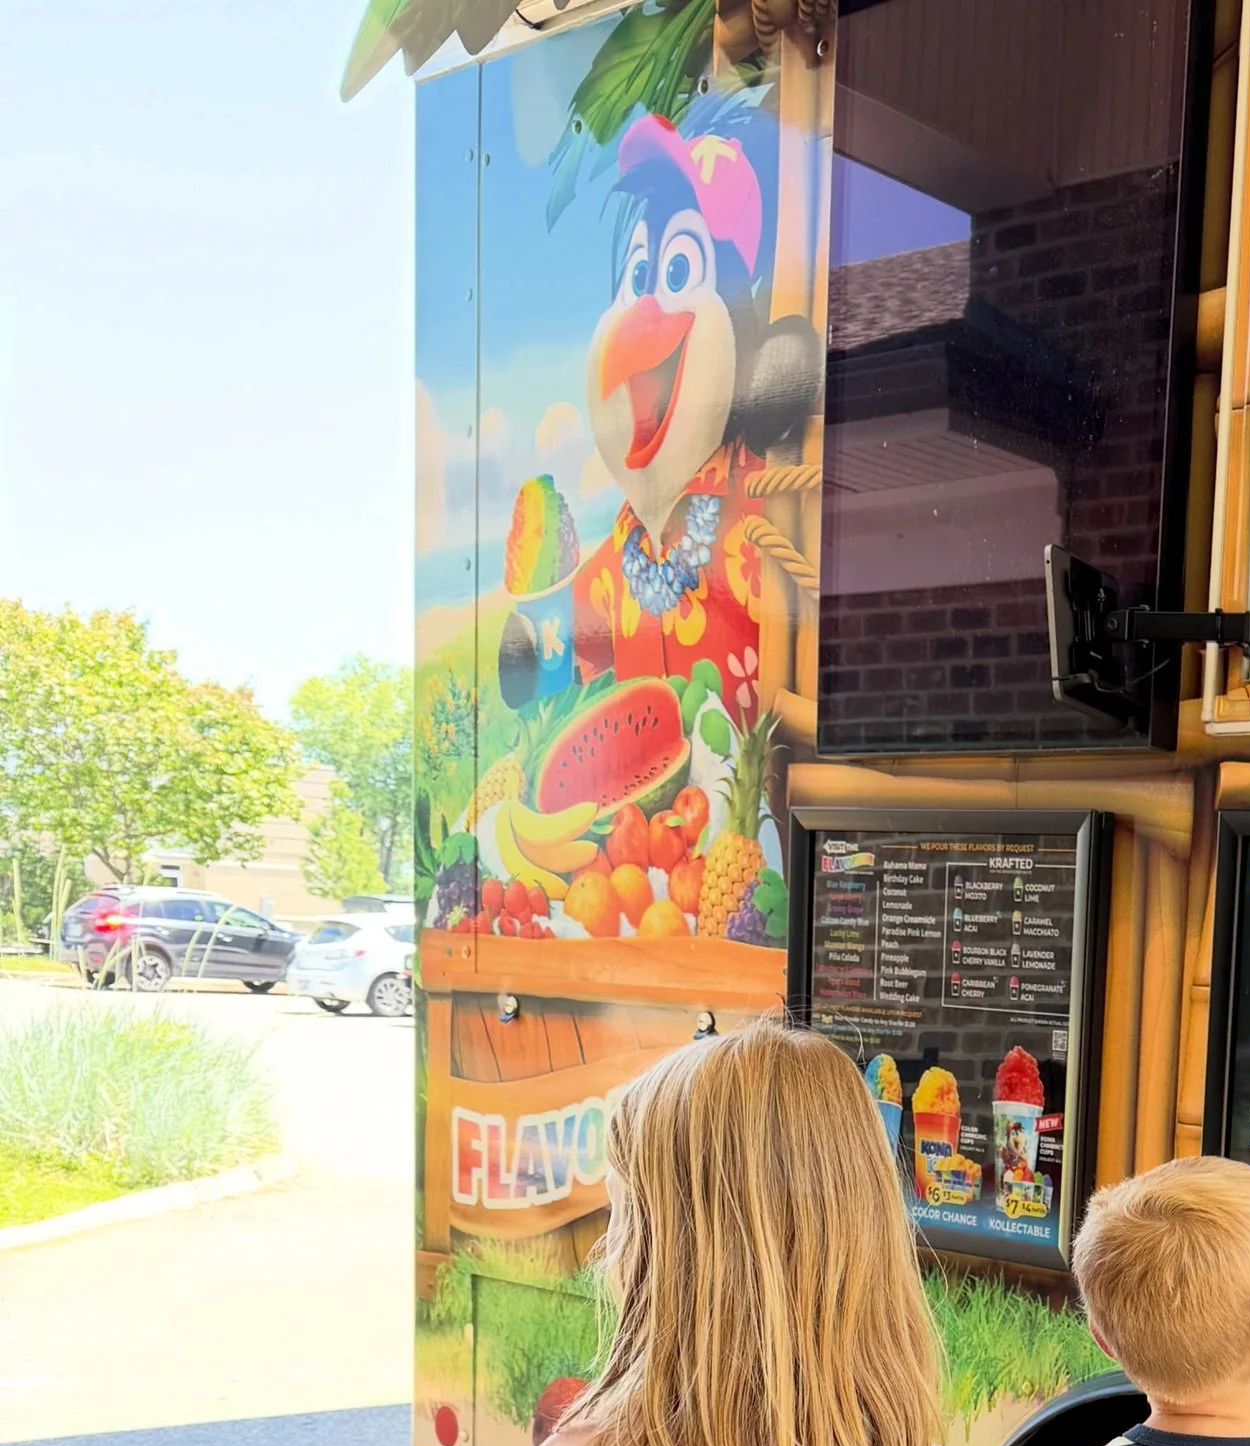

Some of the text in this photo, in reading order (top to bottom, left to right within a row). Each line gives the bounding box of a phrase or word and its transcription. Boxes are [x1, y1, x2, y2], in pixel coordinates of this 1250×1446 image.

[931, 843, 949, 851] POUR
[949, 843, 968, 851] THESE
[969, 844, 996, 852] FLAVORS
[1006, 844, 1035, 853] REQUEST
[988, 858, 1034, 870] KRAFTED
[882, 874, 924, 886] Birthday Cake
[964, 881, 1004, 891] BLACKBERRY
[1024, 884, 1056, 893] COCONUT
[882, 887, 907, 897] Coconut
[1024, 895, 1040, 903] LIME
[882, 900, 913, 911] Lemonade
[881, 913, 936, 925] Orange Creamsicle
[963, 913, 998, 923] BLUEBERRY
[1023, 916, 1053, 926] CARAMEL
[1023, 927, 1060, 938] MACCHIATO
[880, 939, 900, 950] Peach
[962, 946, 1008, 957] BOURBON BLACK
[1022, 950, 1055, 960] LAVENDER
[880, 952, 910, 964] Pineapple
[962, 956, 1006, 967] CHERRY VANILLA
[1021, 960, 1056, 971] LEMONADE
[961, 978, 996, 990] CARIBBEAN
[1020, 983, 1064, 994] POMEGRANATE
[961, 989, 986, 999] CHERRY
[1038, 1117, 1059, 1130] NEW
[452, 1090, 618, 1209] FLAVO
[919, 1139, 953, 1158] KONA
[927, 1186, 940, 1203] $6
[1005, 1197, 1019, 1215] $7
[911, 1205, 978, 1227] COLOR CHANGE
[988, 1218, 1051, 1239] KOLLECTABLE
